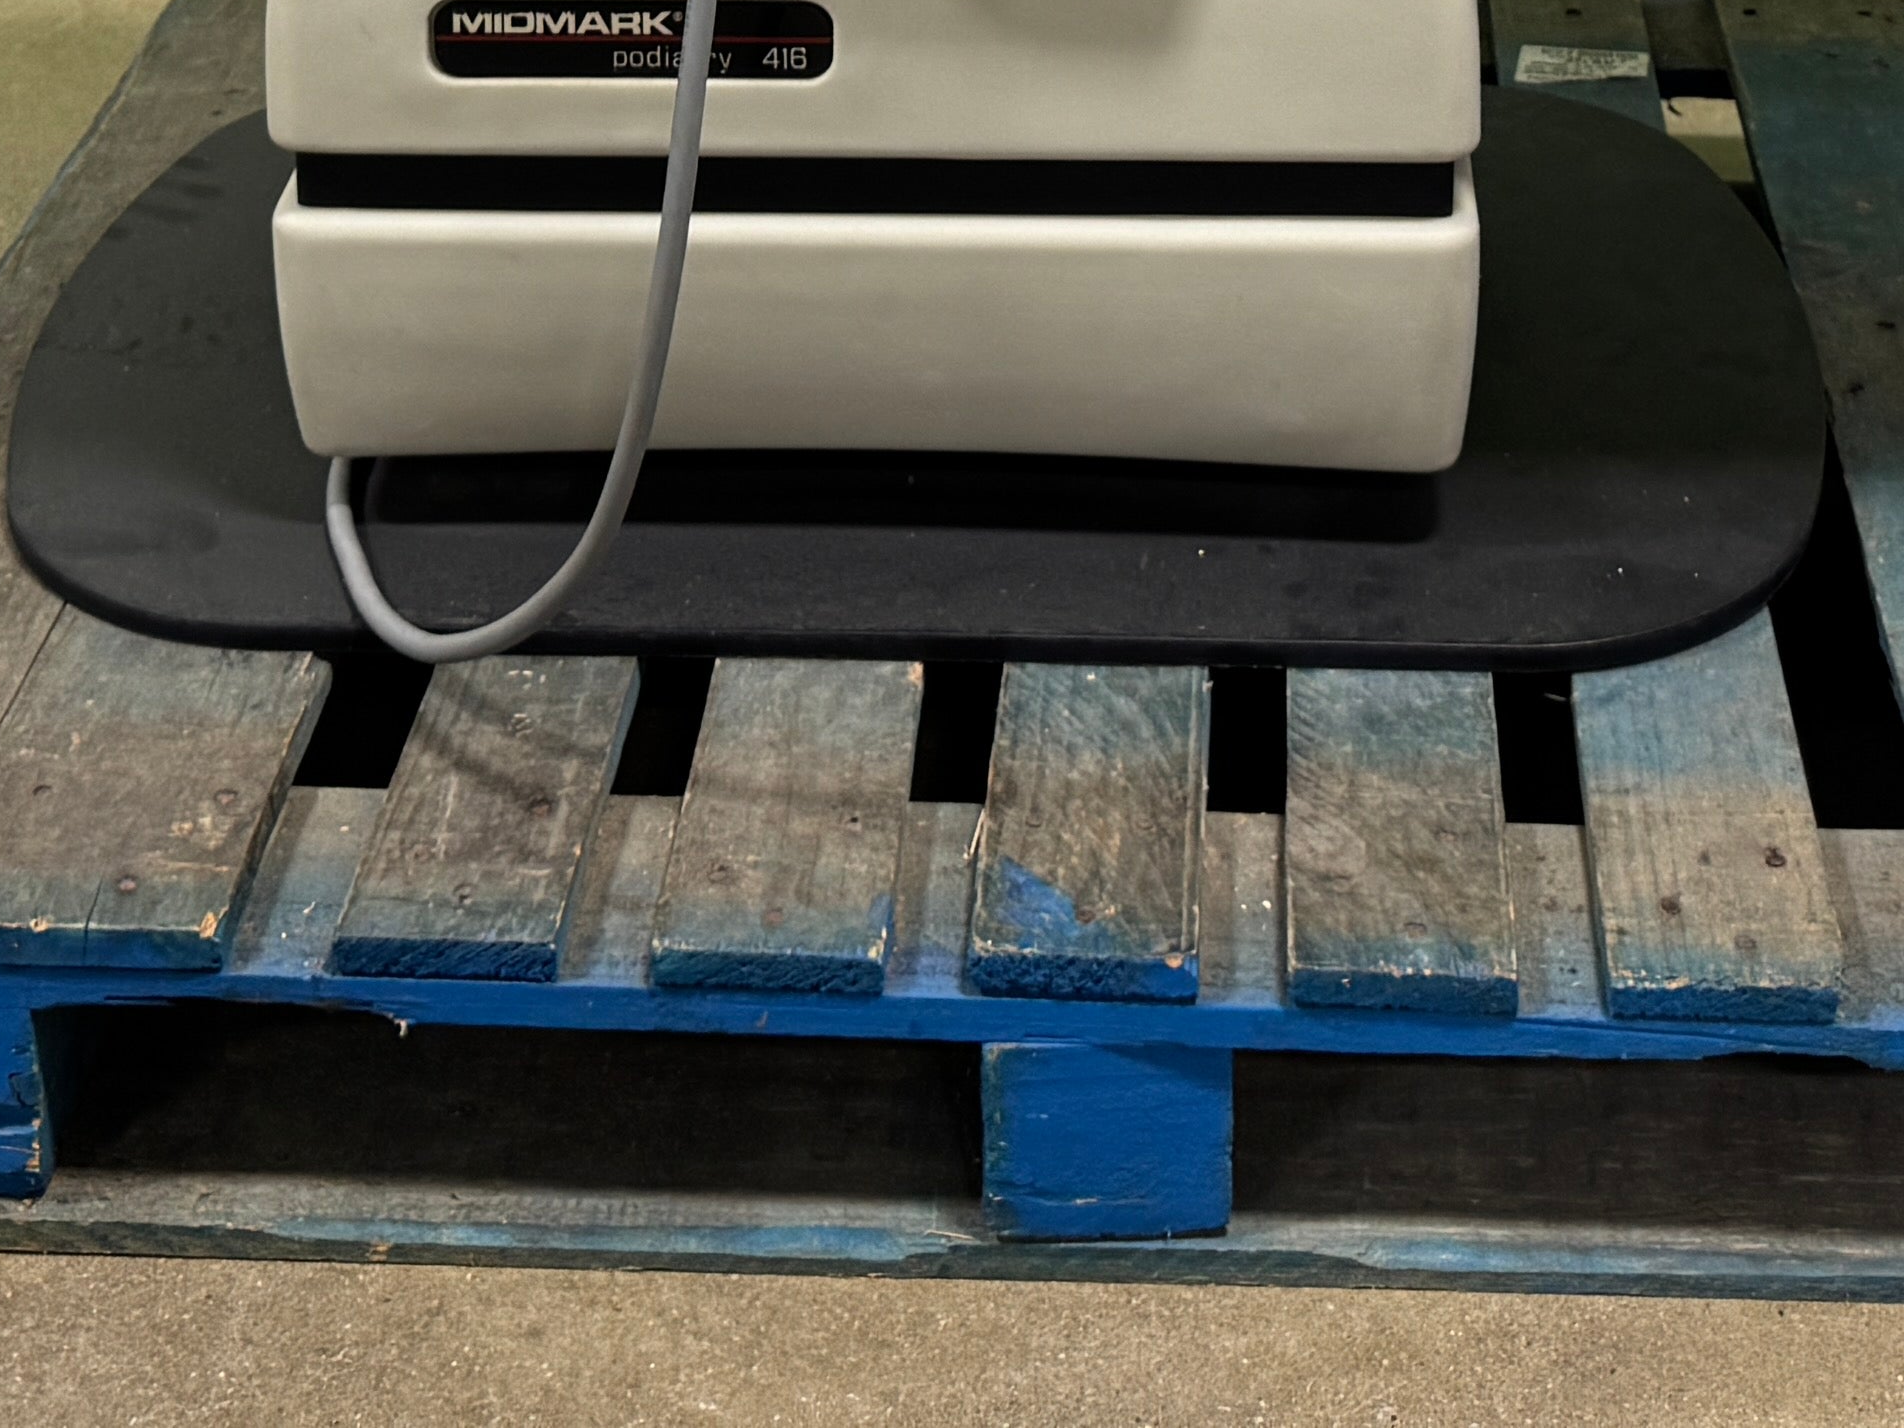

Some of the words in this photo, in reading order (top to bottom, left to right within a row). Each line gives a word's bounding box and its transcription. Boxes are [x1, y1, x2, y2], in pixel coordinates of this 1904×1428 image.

[452, 11, 674, 35] MIDMARK
[613, 45, 732, 74] podiay
[762, 47, 808, 70] 416
